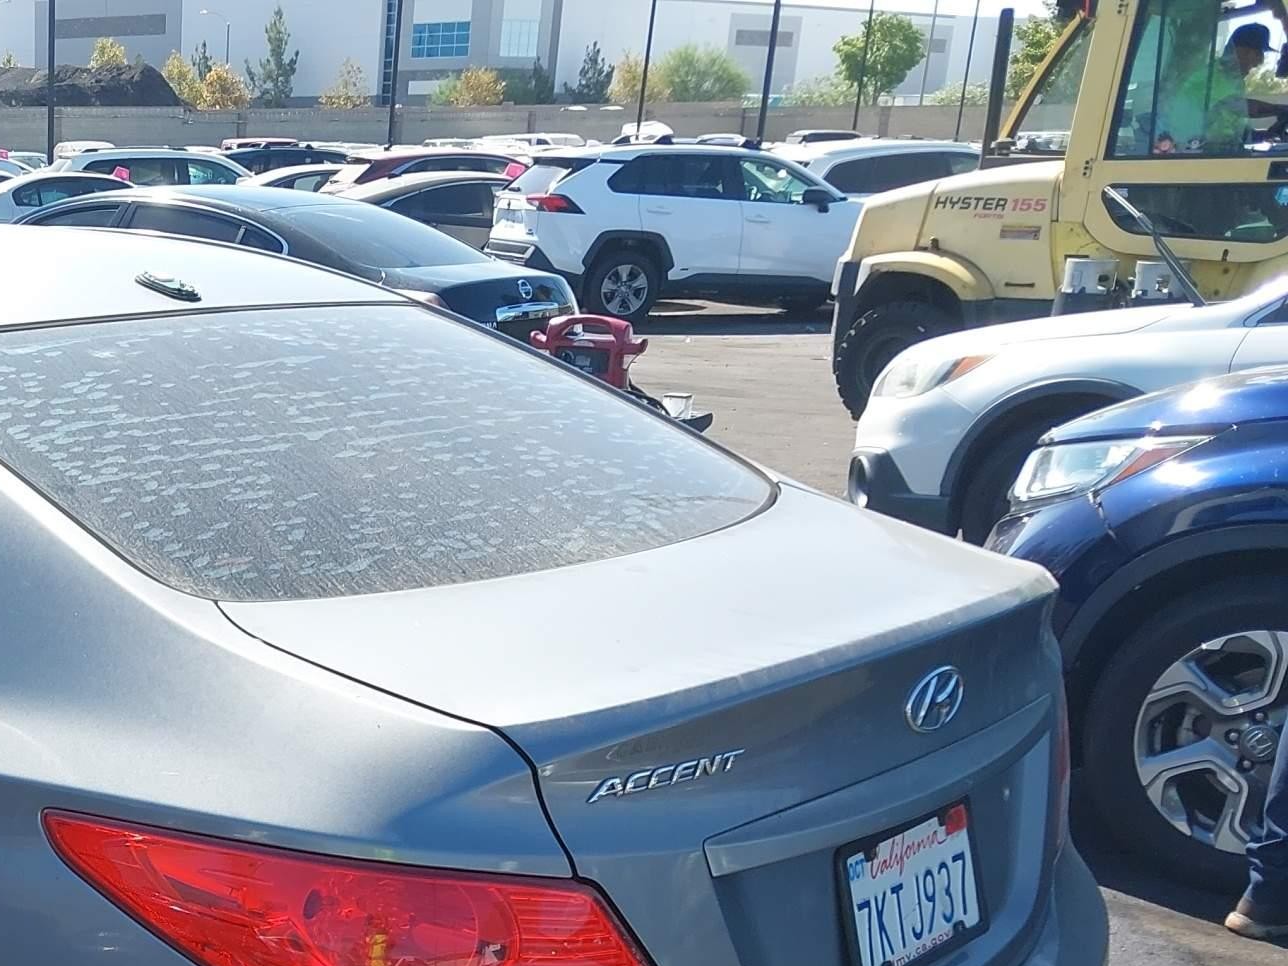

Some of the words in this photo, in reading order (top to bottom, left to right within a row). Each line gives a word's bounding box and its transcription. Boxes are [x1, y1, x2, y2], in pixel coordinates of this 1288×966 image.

[934, 196, 1009, 211] HYSTER
[1011, 198, 1049, 212] 155
[585, 748, 746, 804] ACCENT
[870, 829, 947, 880] California
[856, 850, 967, 966] 7KTJ937
